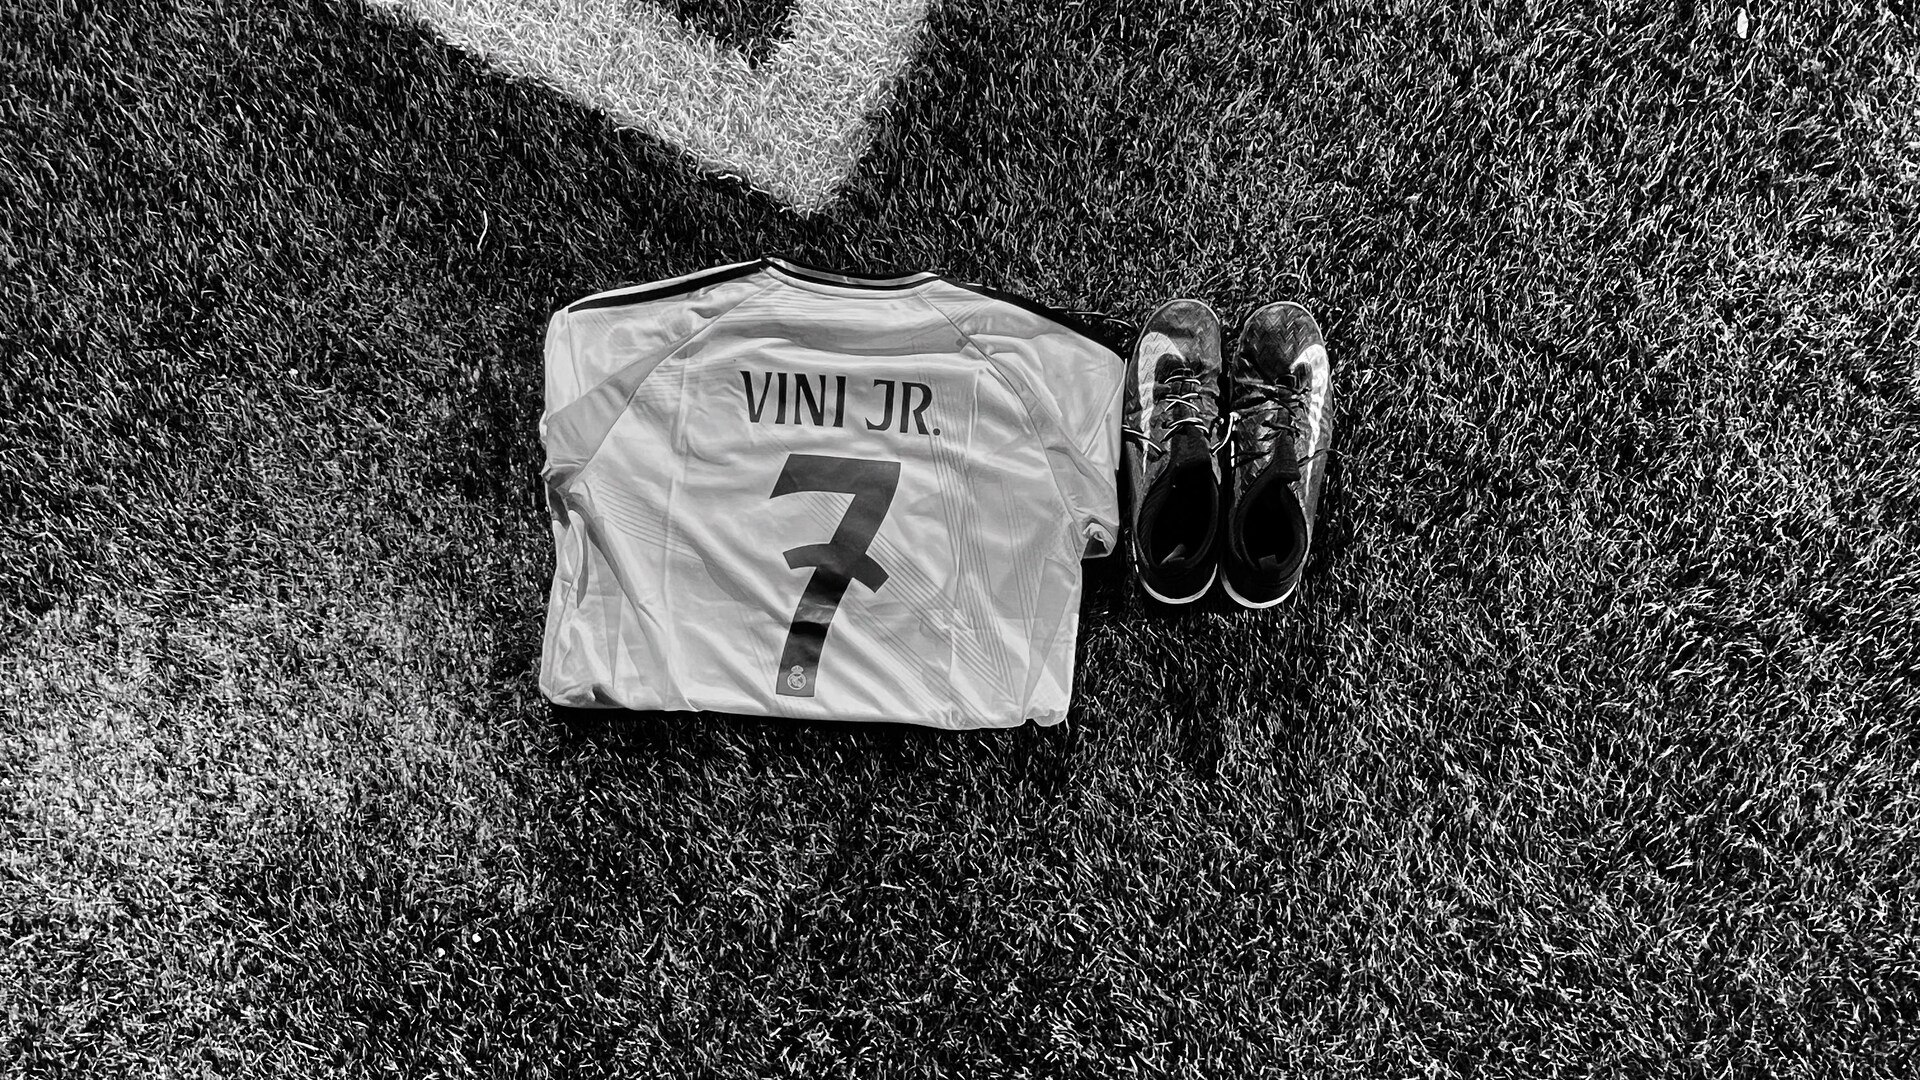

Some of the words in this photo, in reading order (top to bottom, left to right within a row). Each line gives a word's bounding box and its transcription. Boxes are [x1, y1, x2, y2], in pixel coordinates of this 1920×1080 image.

[740, 371, 846, 428] VINI
[865, 379, 941, 436] JR.
[769, 453, 901, 697] 7
